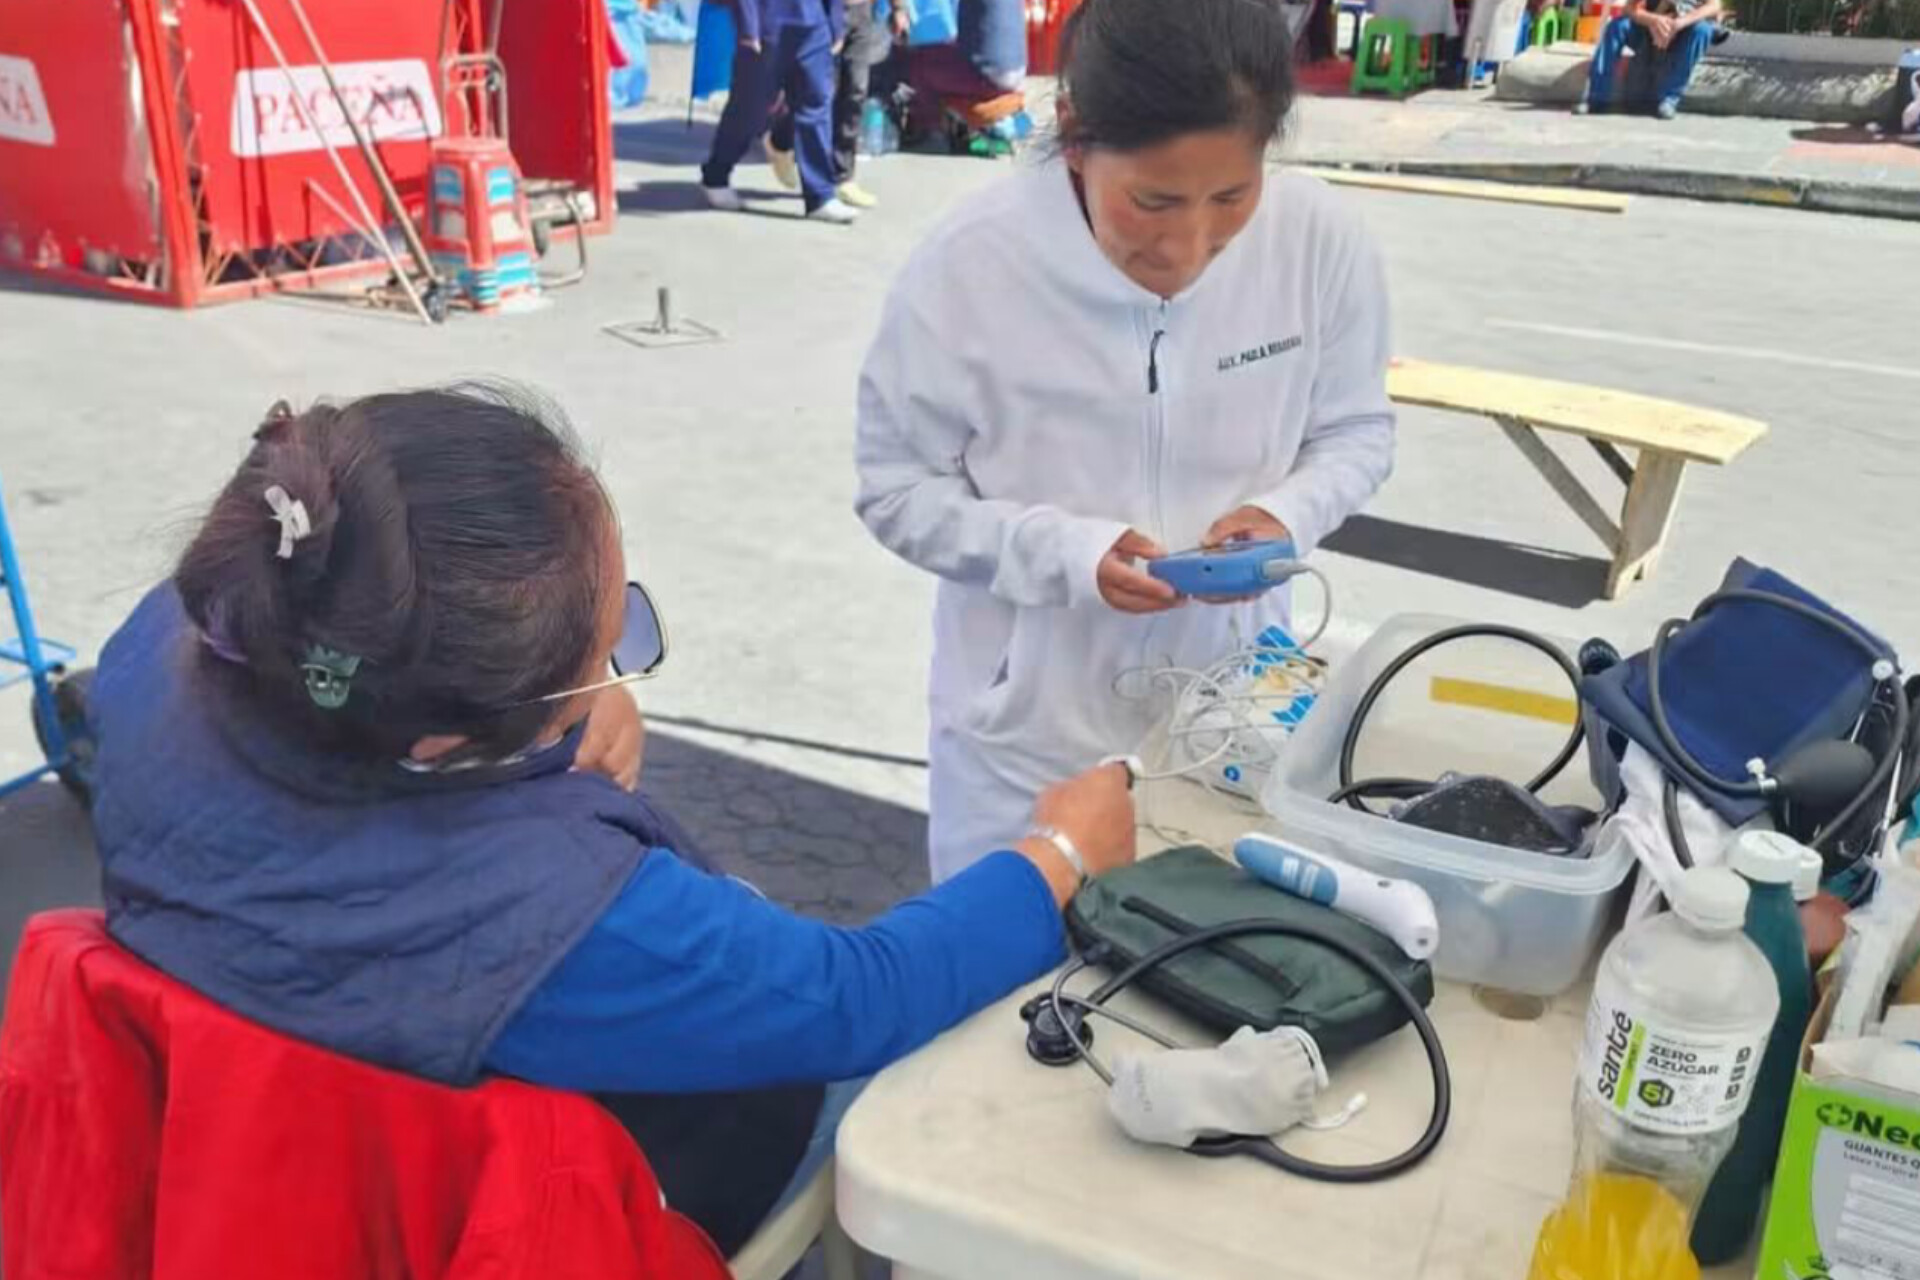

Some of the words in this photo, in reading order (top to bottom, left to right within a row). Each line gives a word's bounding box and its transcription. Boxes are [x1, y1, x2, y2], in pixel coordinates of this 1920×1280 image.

[254, 75, 424, 134] PACEÑA
[1598, 1009, 1633, 1100] santé
[1649, 1043, 1697, 1063] ZERO
[1844, 1138, 1908, 1165] GUANTES
